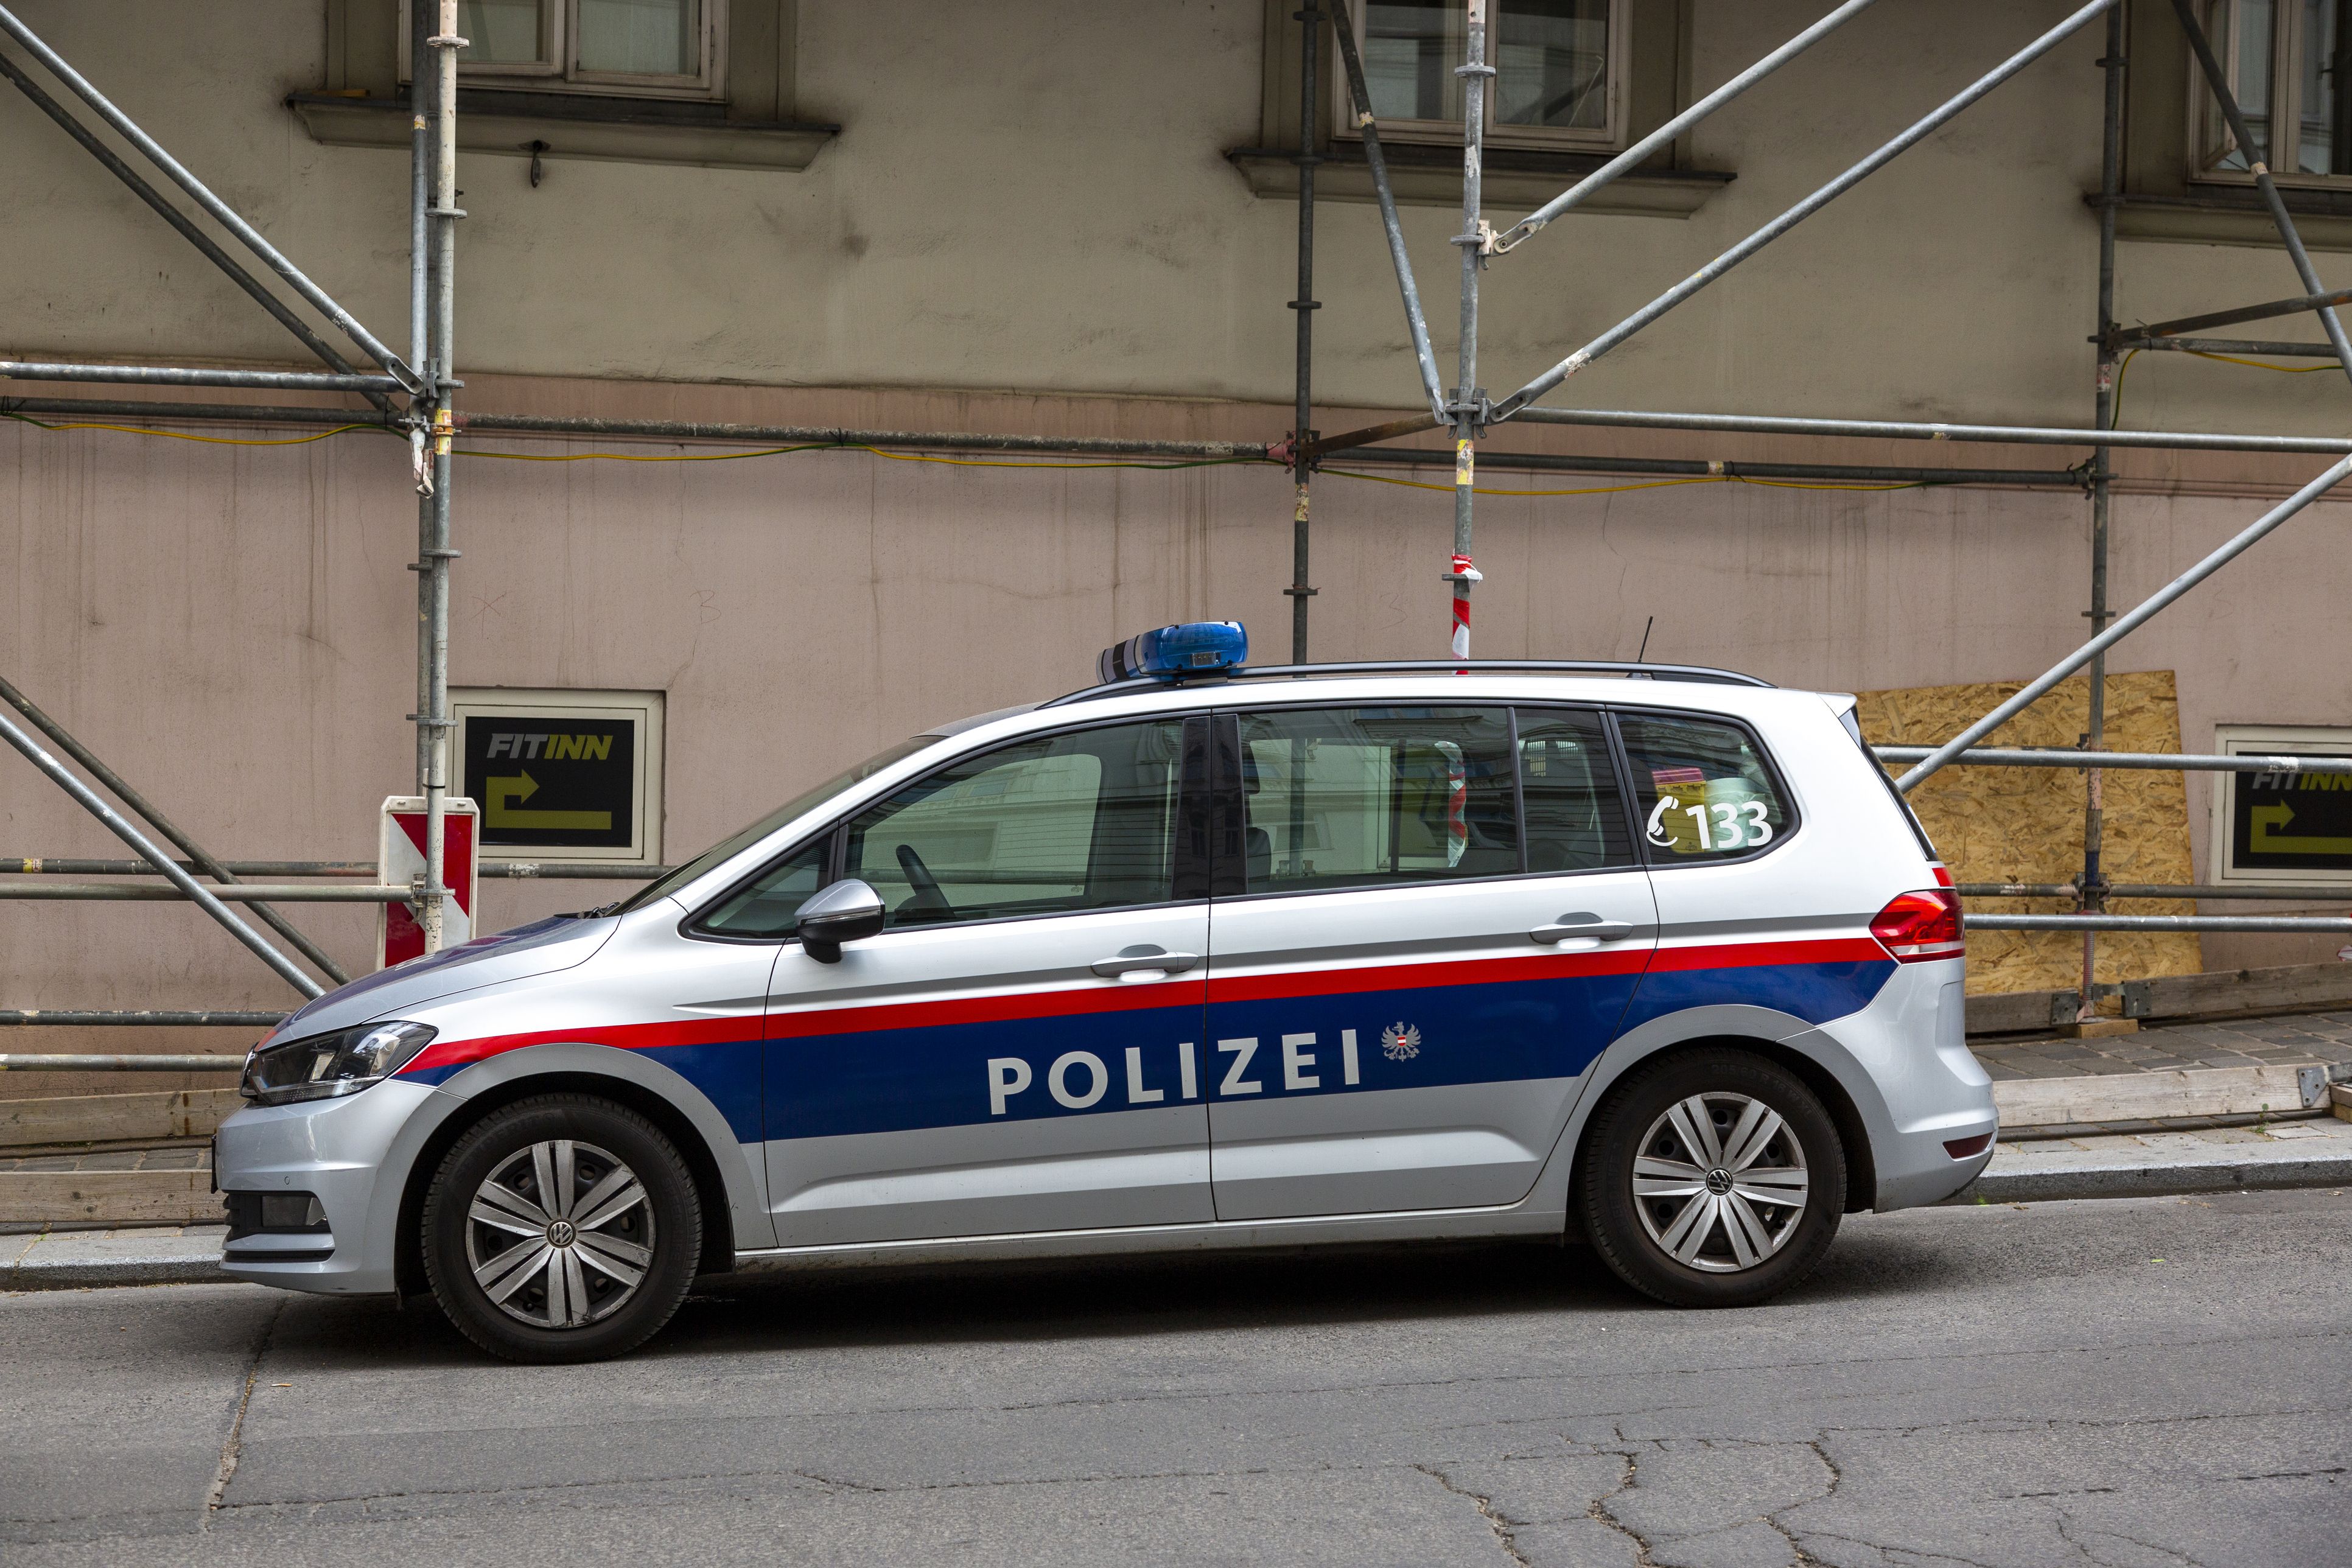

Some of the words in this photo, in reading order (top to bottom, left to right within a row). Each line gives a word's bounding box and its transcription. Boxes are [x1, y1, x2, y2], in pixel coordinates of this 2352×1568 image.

[486, 733, 614, 760] FITINN
[1685, 800, 1773, 849] 133
[987, 1029, 1360, 1115] POLIZEI
